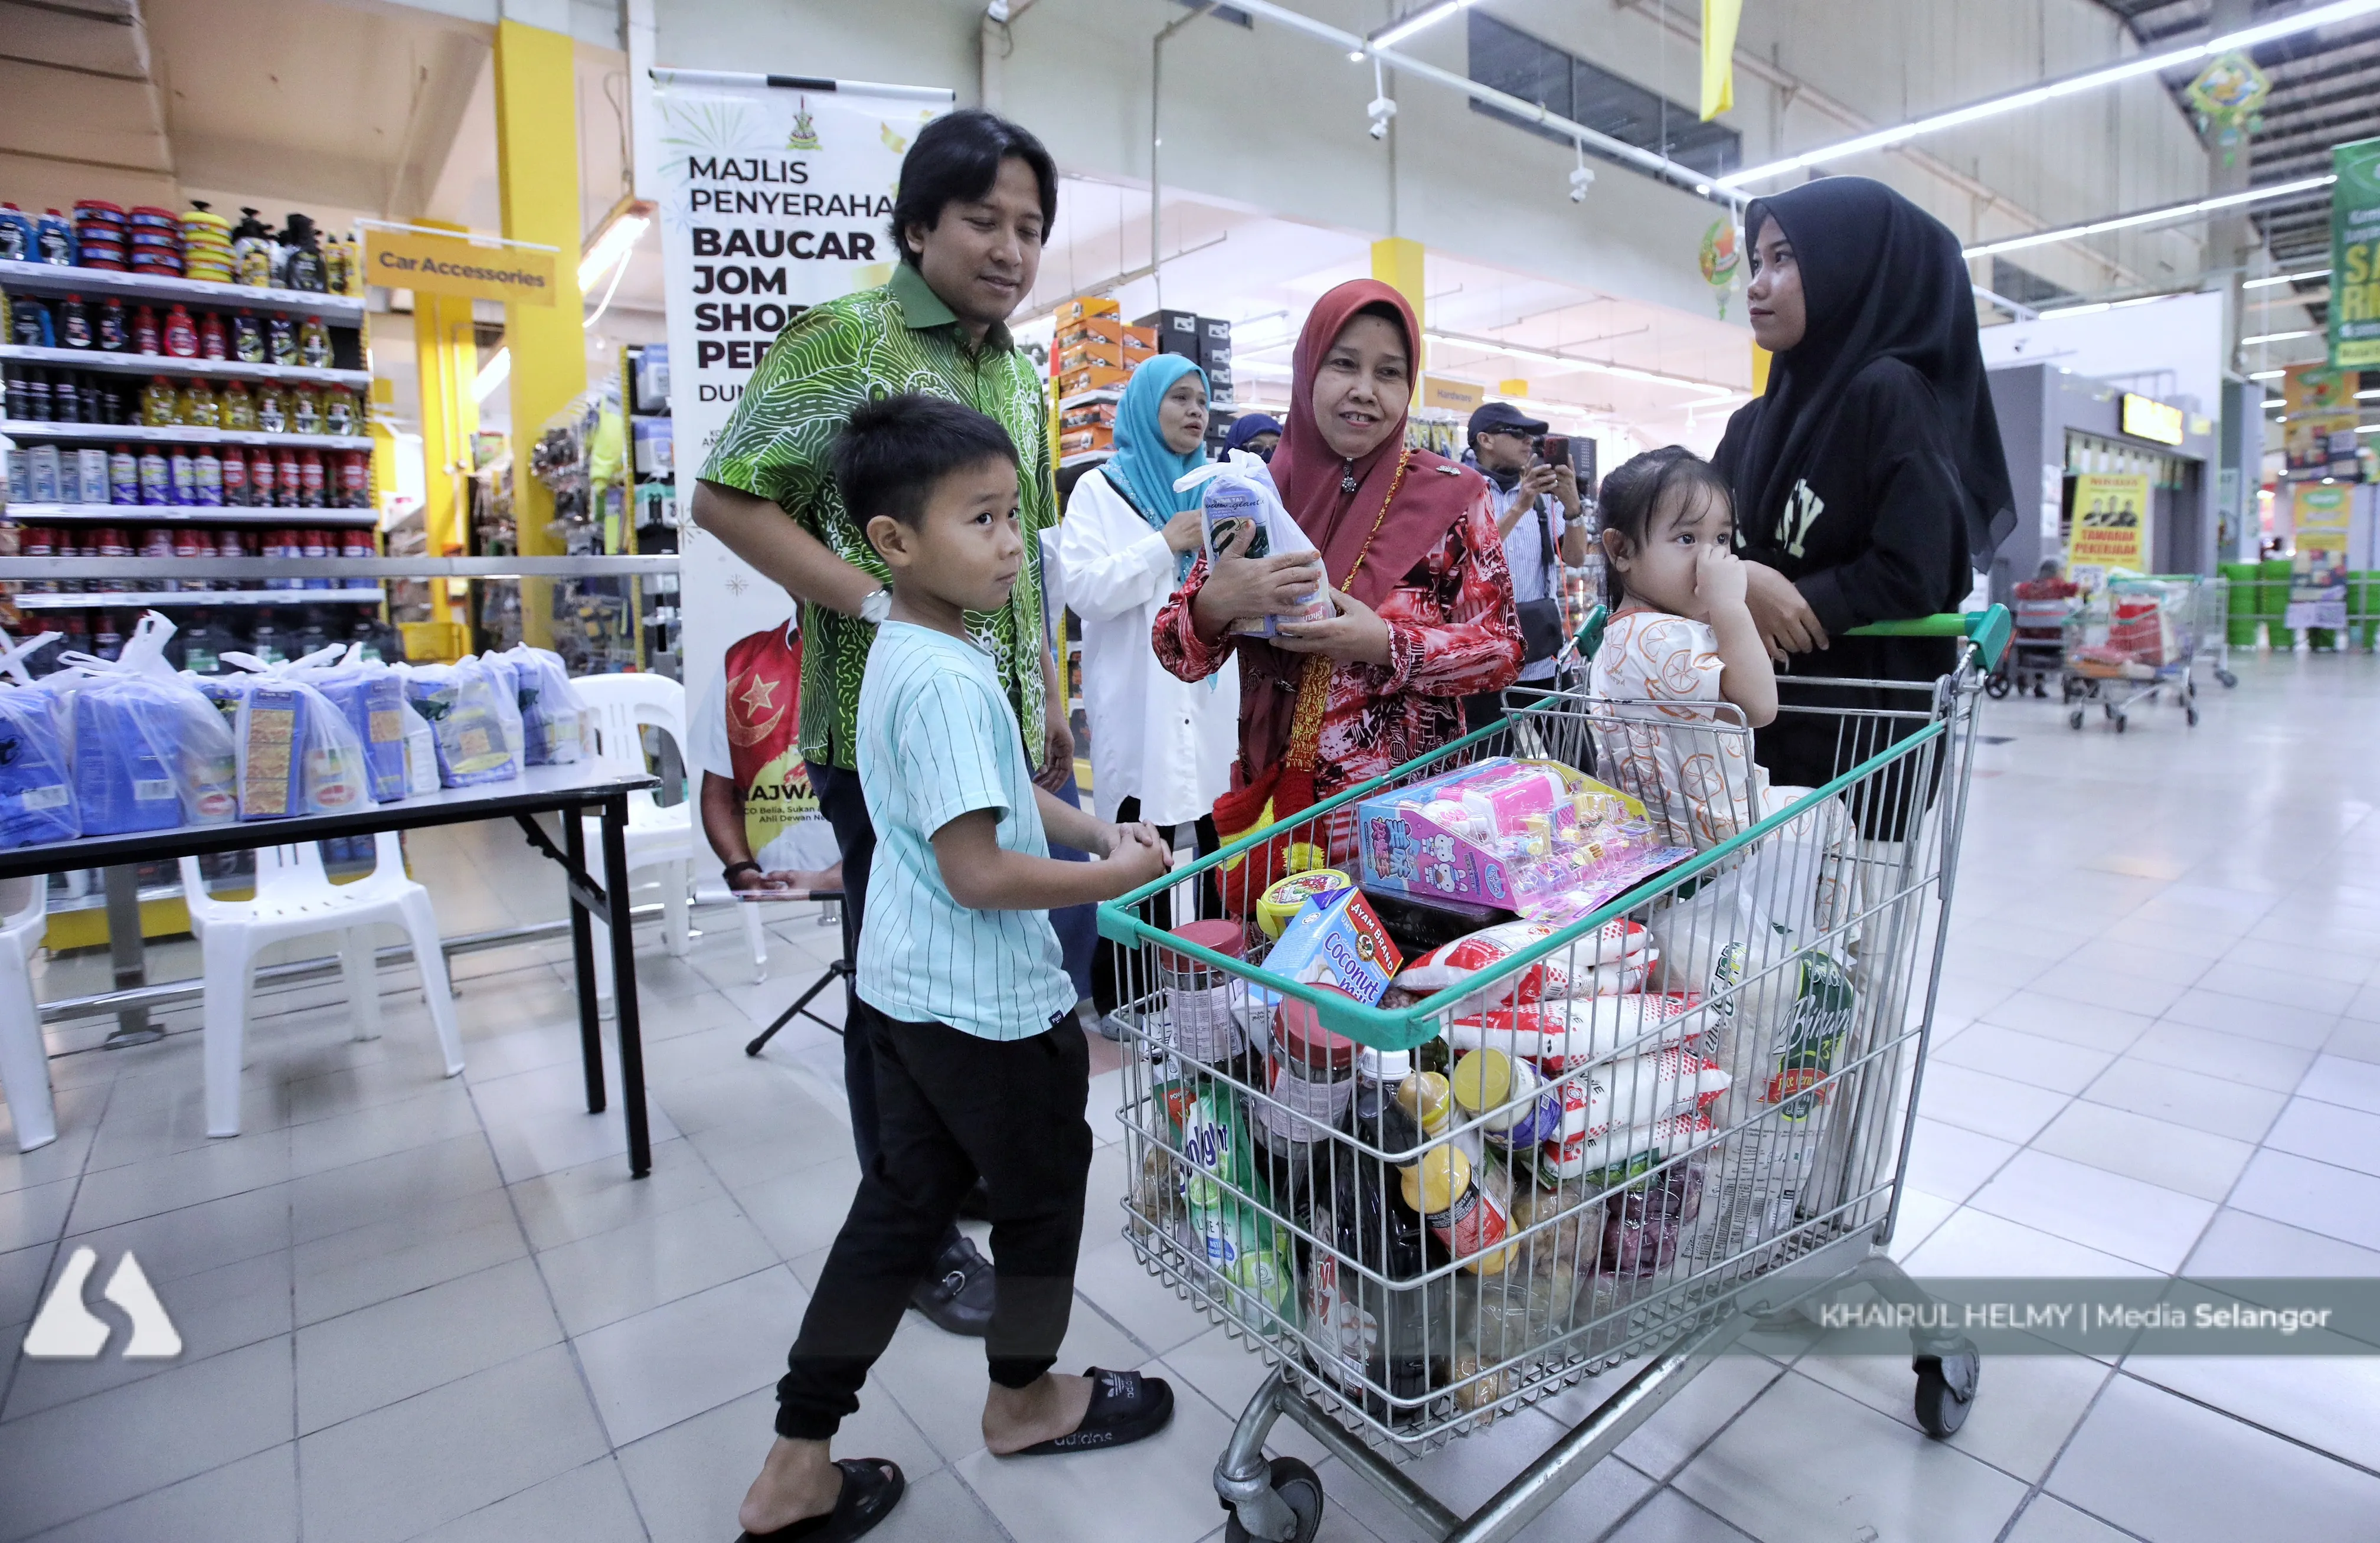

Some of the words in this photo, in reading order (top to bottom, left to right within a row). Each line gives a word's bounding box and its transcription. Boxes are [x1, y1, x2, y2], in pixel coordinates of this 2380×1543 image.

[689, 156, 809, 184] MAJLIS
[692, 227, 875, 260] BAUCAR
[379, 250, 417, 270] Car
[421, 257, 545, 288] Accessories
[692, 265, 787, 295] JOM
[1437, 388, 1473, 402] Hardware
[760, 806, 784, 815] Belia,
[787, 805, 815, 813] Sukan
[779, 814, 811, 822] Dewan
[1490, 868, 1500, 884] Pink
[1351, 903, 1375, 930] AYAM
[1374, 929, 1394, 971] BRAND
[1324, 931, 1380, 1002] Coconut
